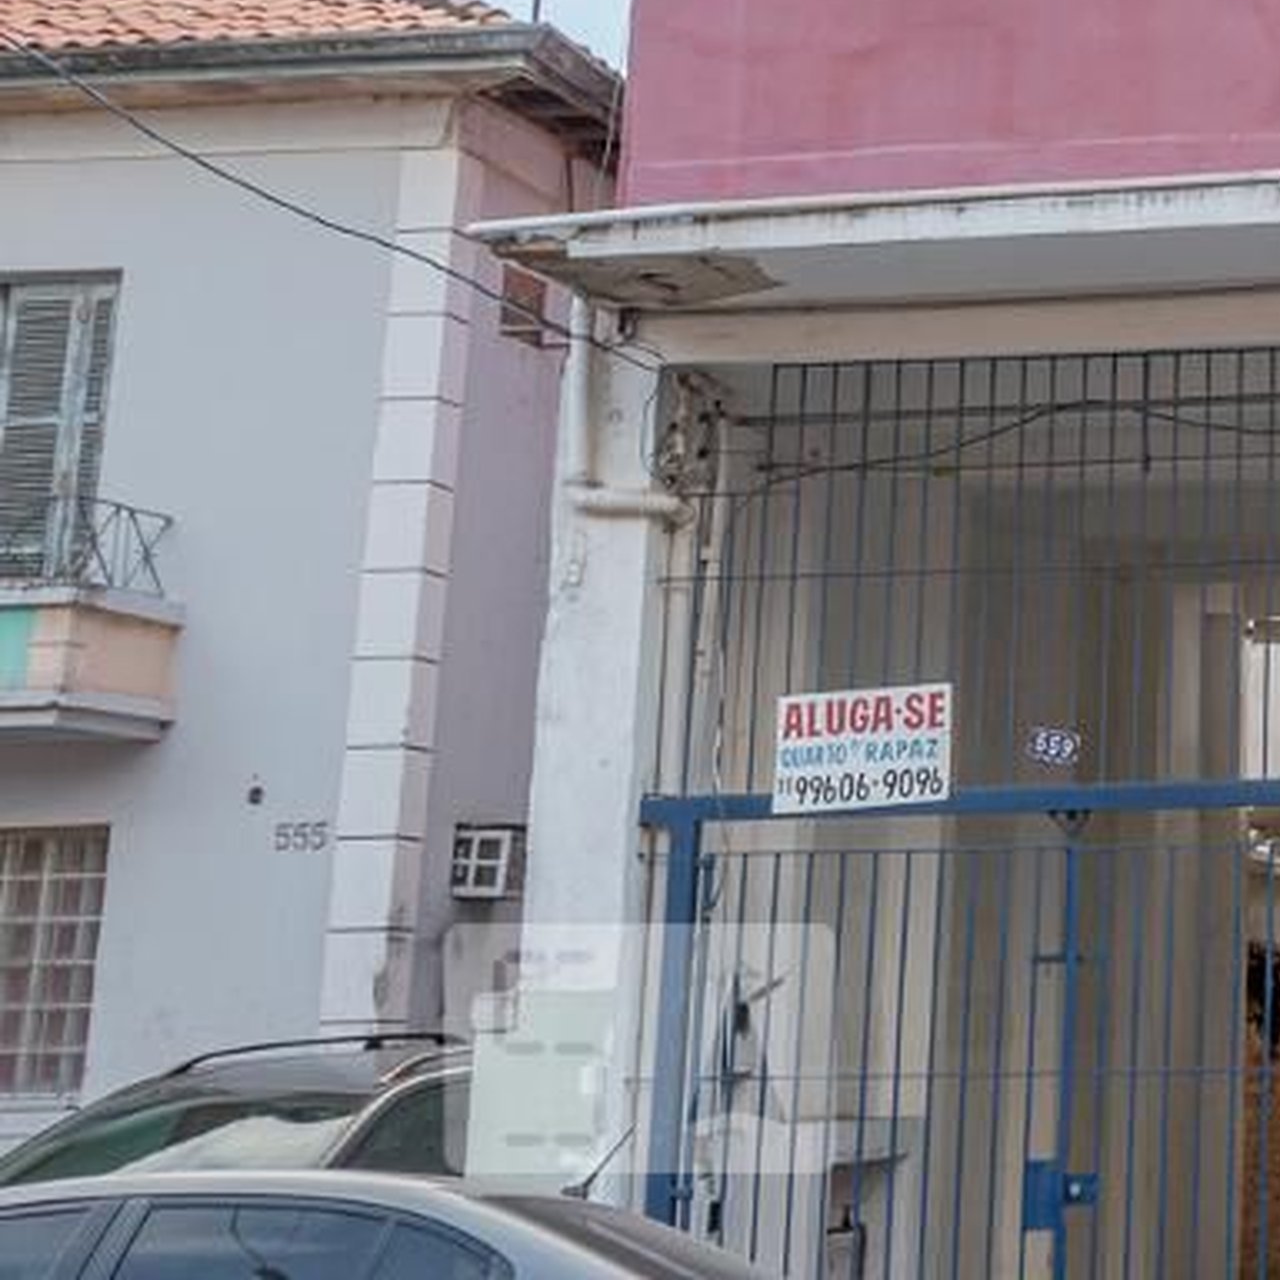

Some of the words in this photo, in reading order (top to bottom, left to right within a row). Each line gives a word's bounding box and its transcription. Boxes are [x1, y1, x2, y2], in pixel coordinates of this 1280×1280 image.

[783, 692, 945, 740] ALUGA-SE
[865, 738, 938, 763] RAPAZ
[276, 821, 328, 851] 555
